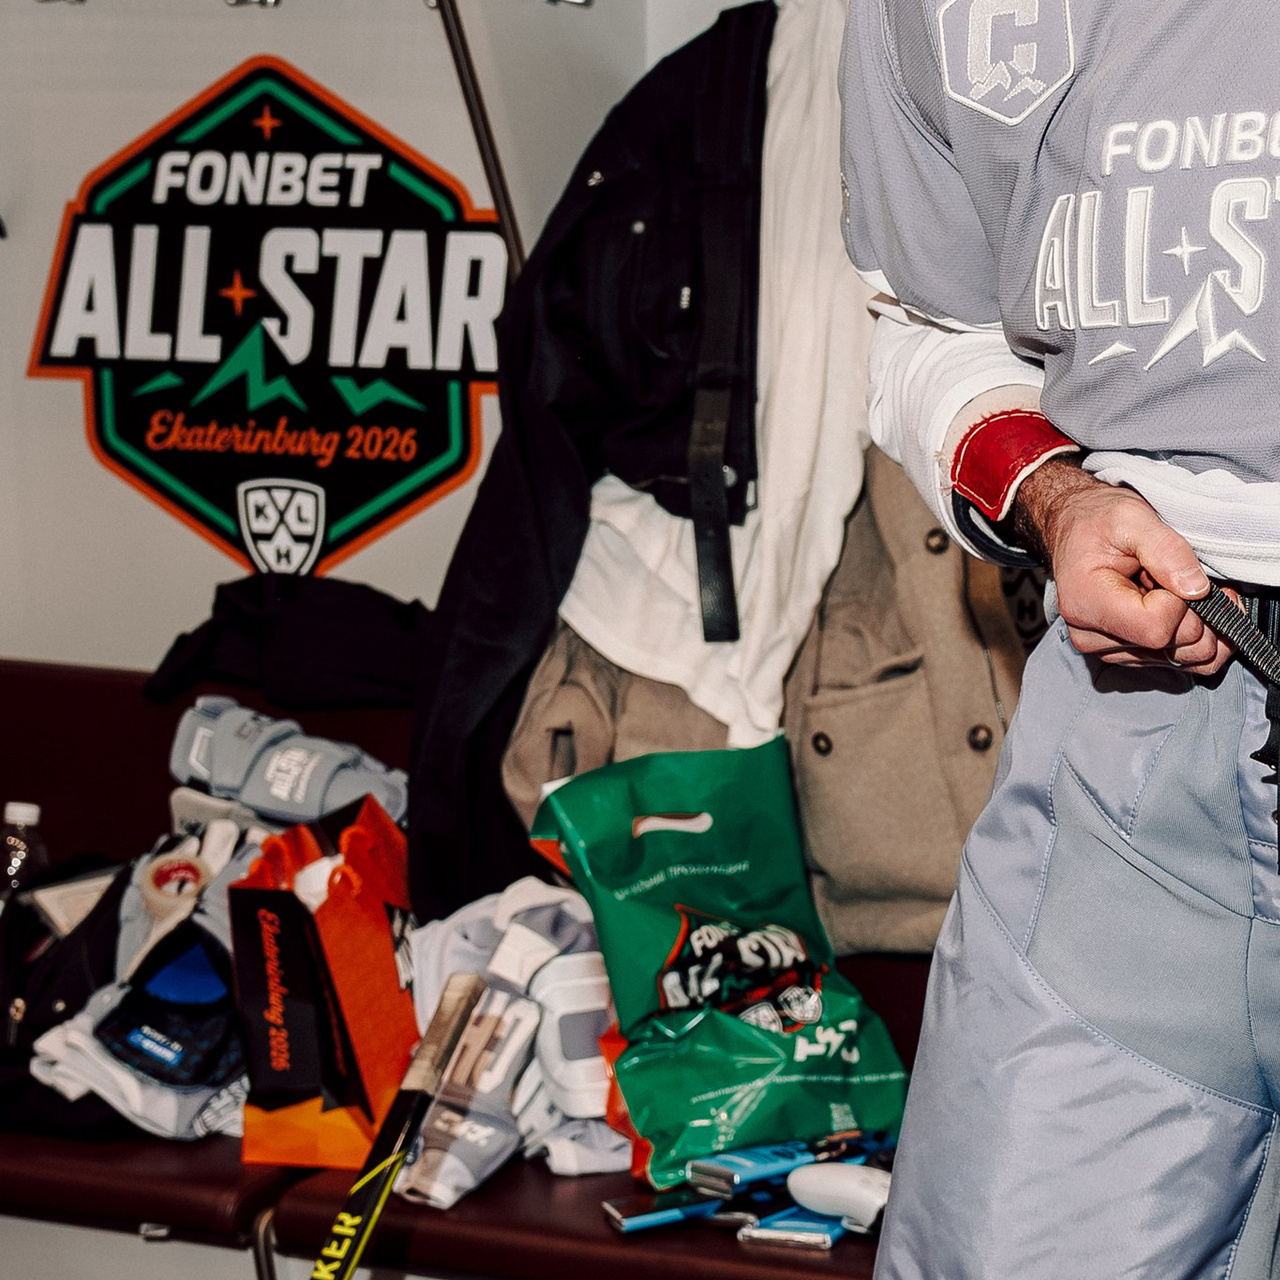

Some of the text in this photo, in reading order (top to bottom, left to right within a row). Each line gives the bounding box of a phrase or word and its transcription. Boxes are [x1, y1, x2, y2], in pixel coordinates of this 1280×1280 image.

[152, 150, 383, 208] FONBET
[50, 223, 508, 372] ALL STAR
[1034, 186, 1172, 333] ALL
[144, 409, 418, 469] Ekaterinburg 2026
